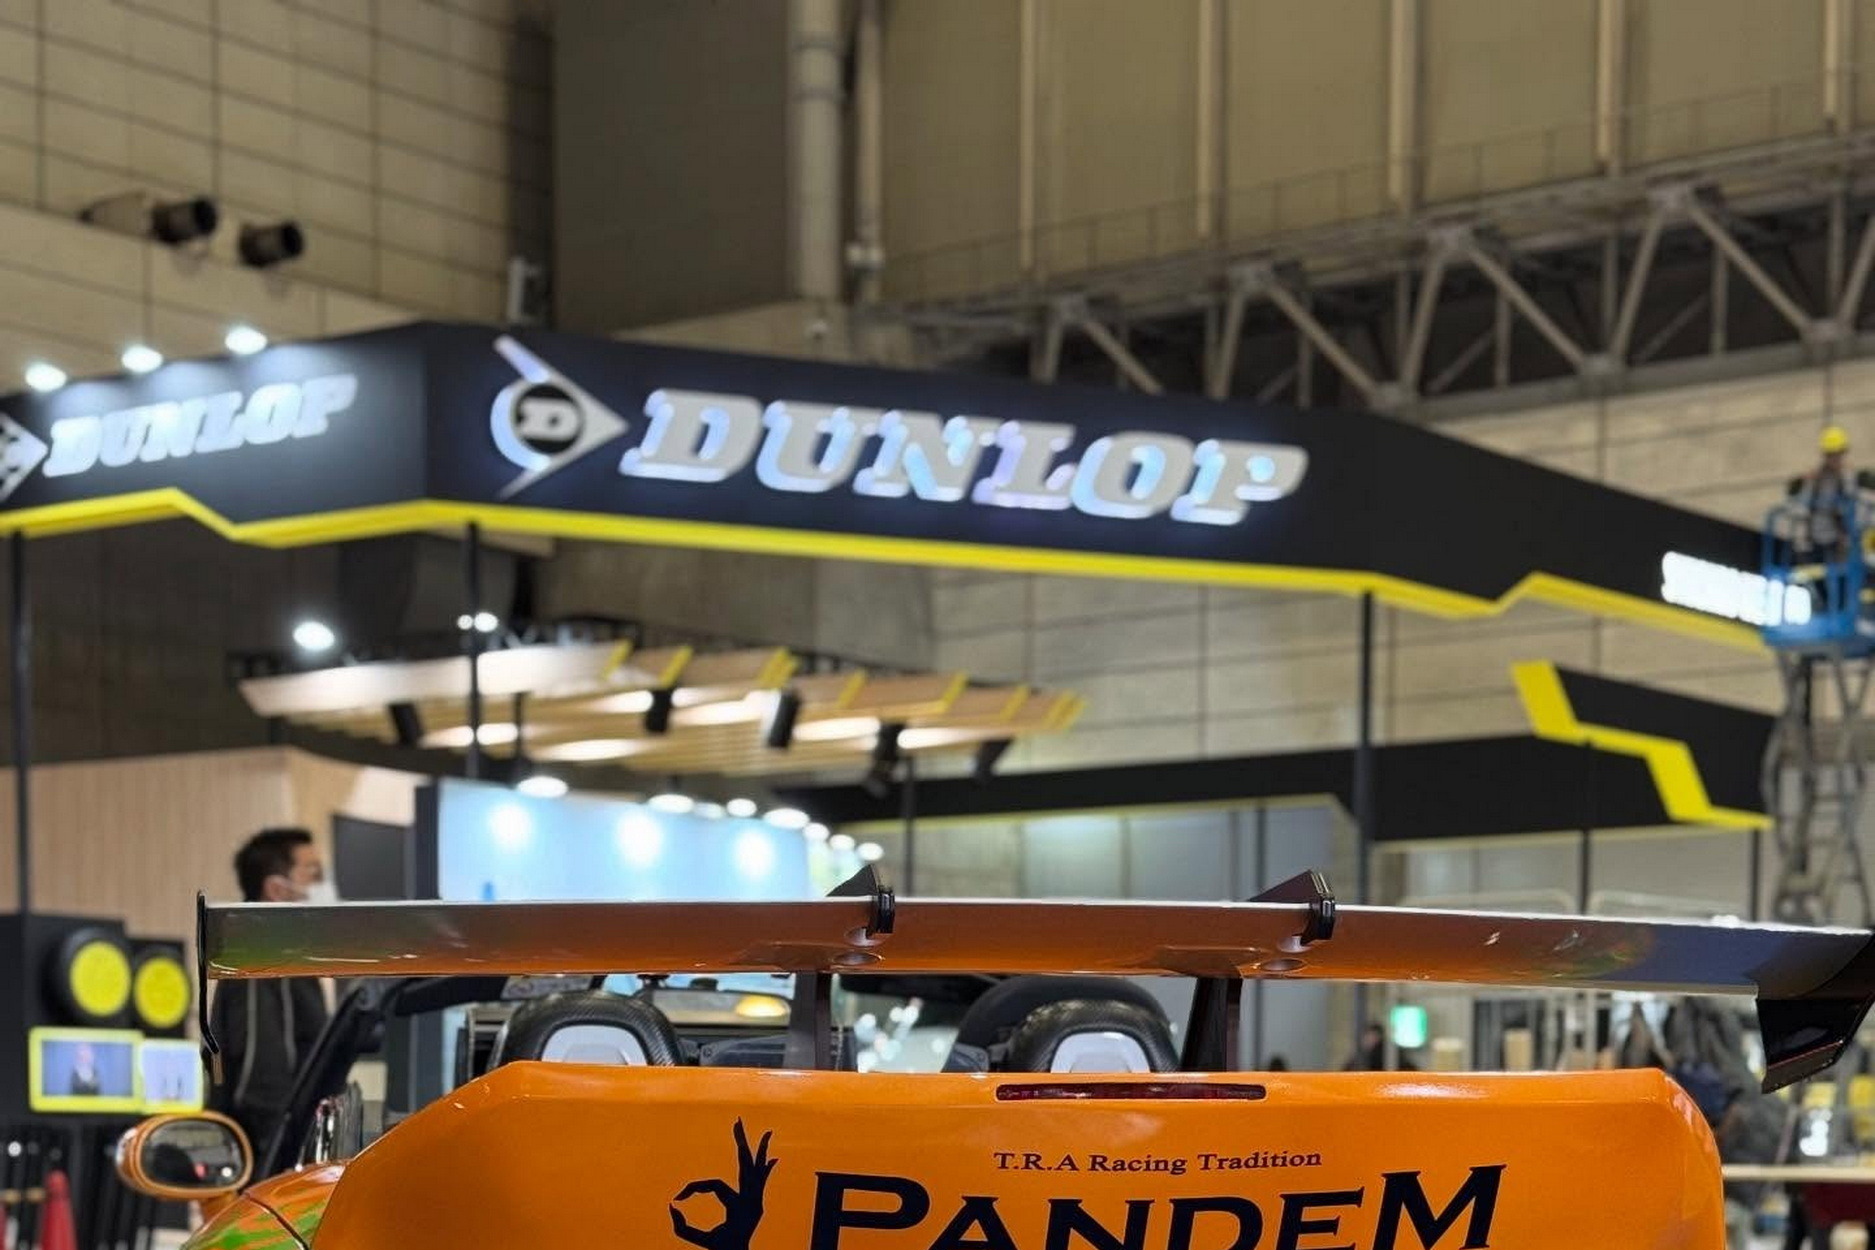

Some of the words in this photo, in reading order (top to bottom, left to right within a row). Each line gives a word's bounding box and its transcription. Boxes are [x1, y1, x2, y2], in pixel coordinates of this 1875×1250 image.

[42, 374, 357, 477] DUNLOP
[618, 388, 1309, 526] DUNLOP
[994, 1152, 1080, 1172] T.R.A
[1086, 1153, 1189, 1176] Racing
[1197, 1150, 1323, 1171] Tradition
